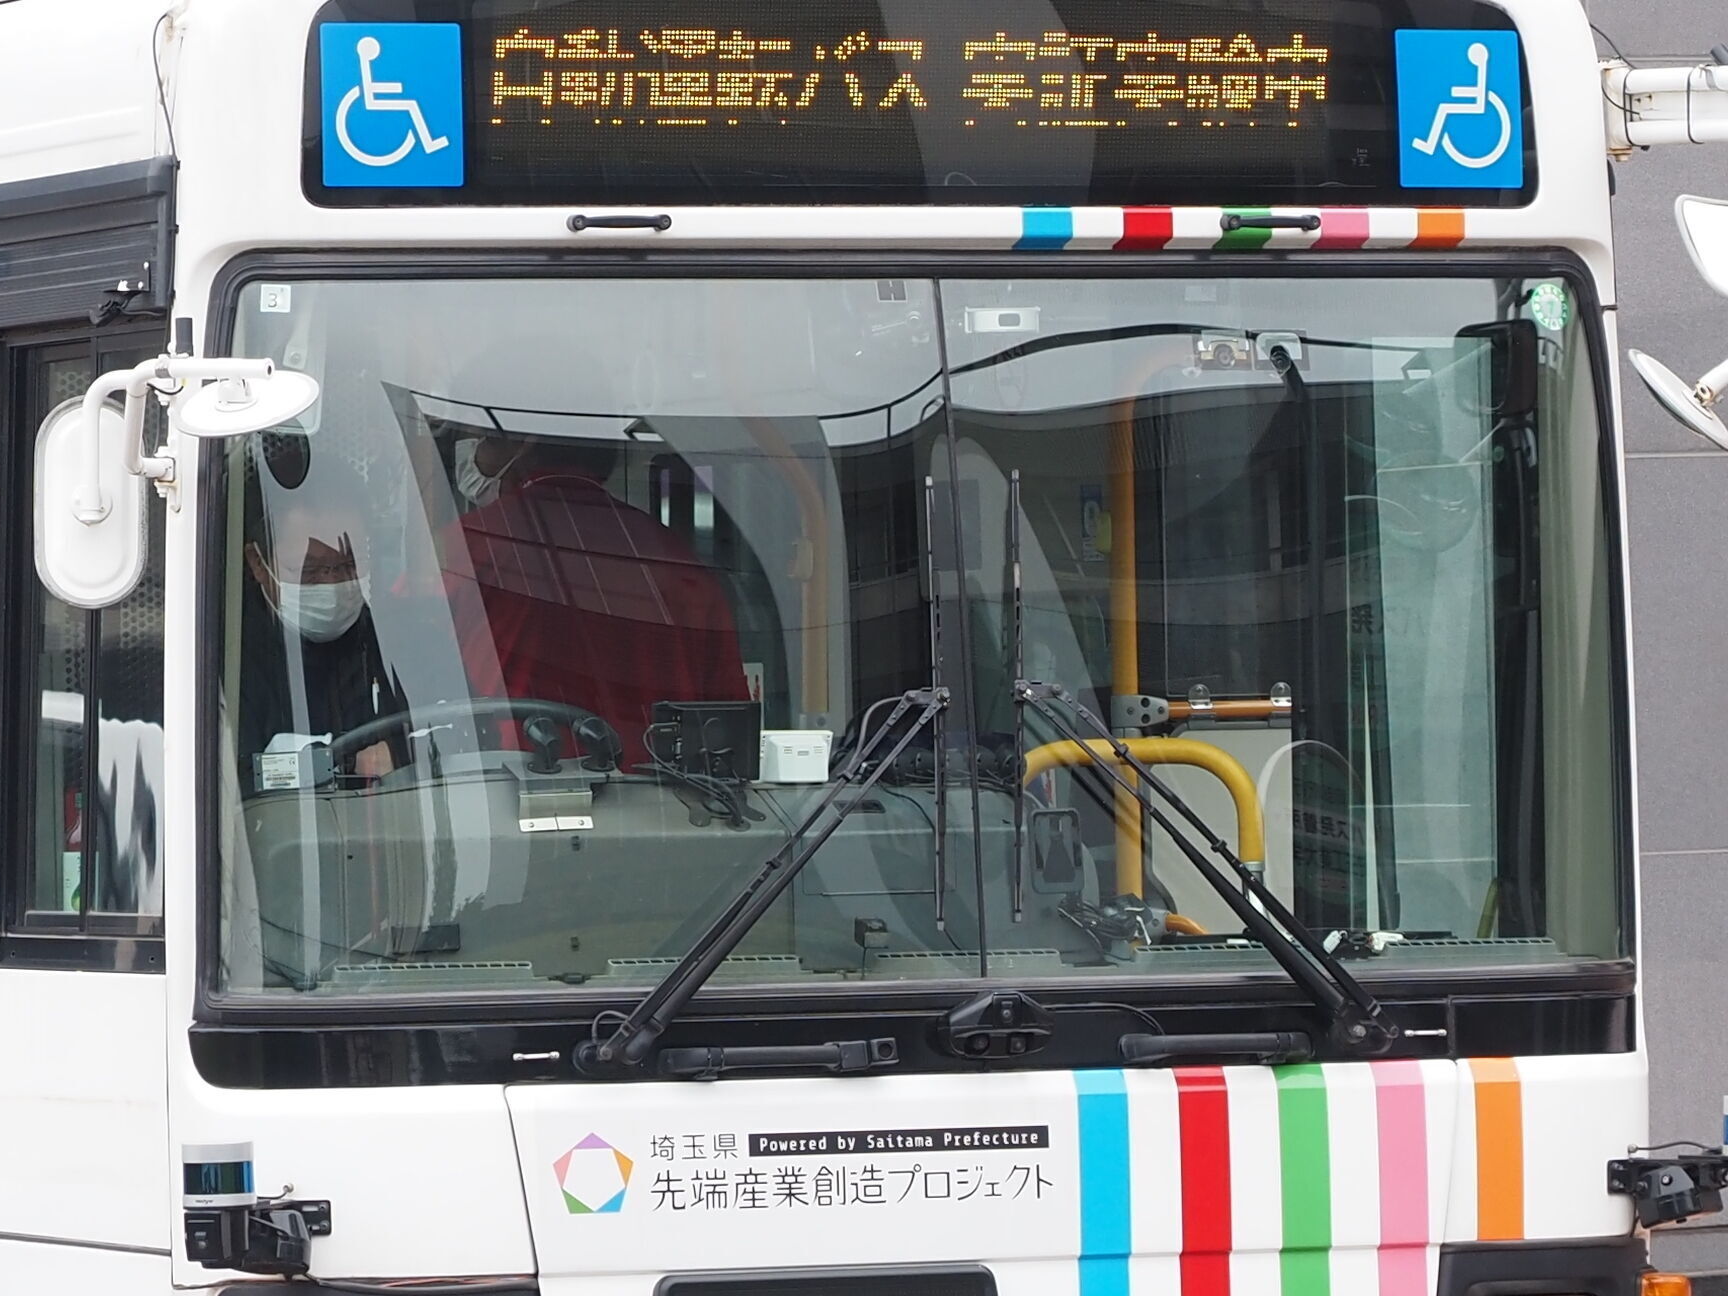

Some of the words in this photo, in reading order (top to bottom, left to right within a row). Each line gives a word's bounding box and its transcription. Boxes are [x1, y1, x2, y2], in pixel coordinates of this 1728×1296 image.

[650, 1133, 740, 1162] 埼玉県
[758, 1135, 828, 1153] Powered
[837, 1134, 857, 1153] by
[866, 1132, 934, 1150] Saitama
[943, 1129, 1040, 1148] Prefecture
[650, 1163, 1054, 1212] 先端産業創造プロジェクト
